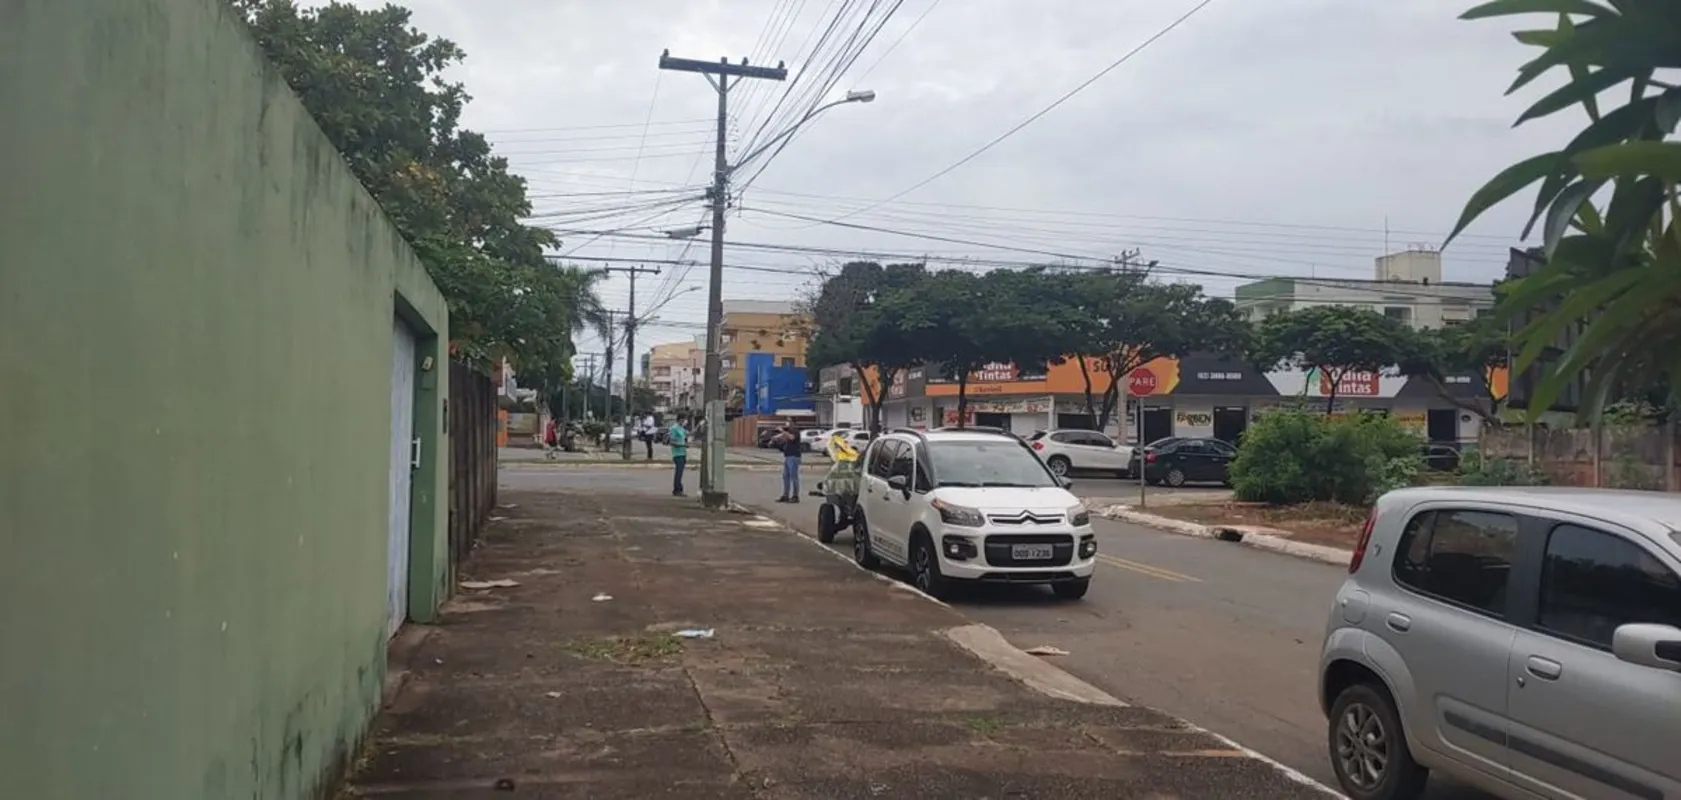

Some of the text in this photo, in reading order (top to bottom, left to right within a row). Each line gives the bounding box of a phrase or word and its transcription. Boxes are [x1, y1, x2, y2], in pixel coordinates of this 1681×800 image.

[978, 370, 1012, 380] Tintas
[1130, 375, 1156, 387] PARE
[1337, 382, 1372, 394] intas
